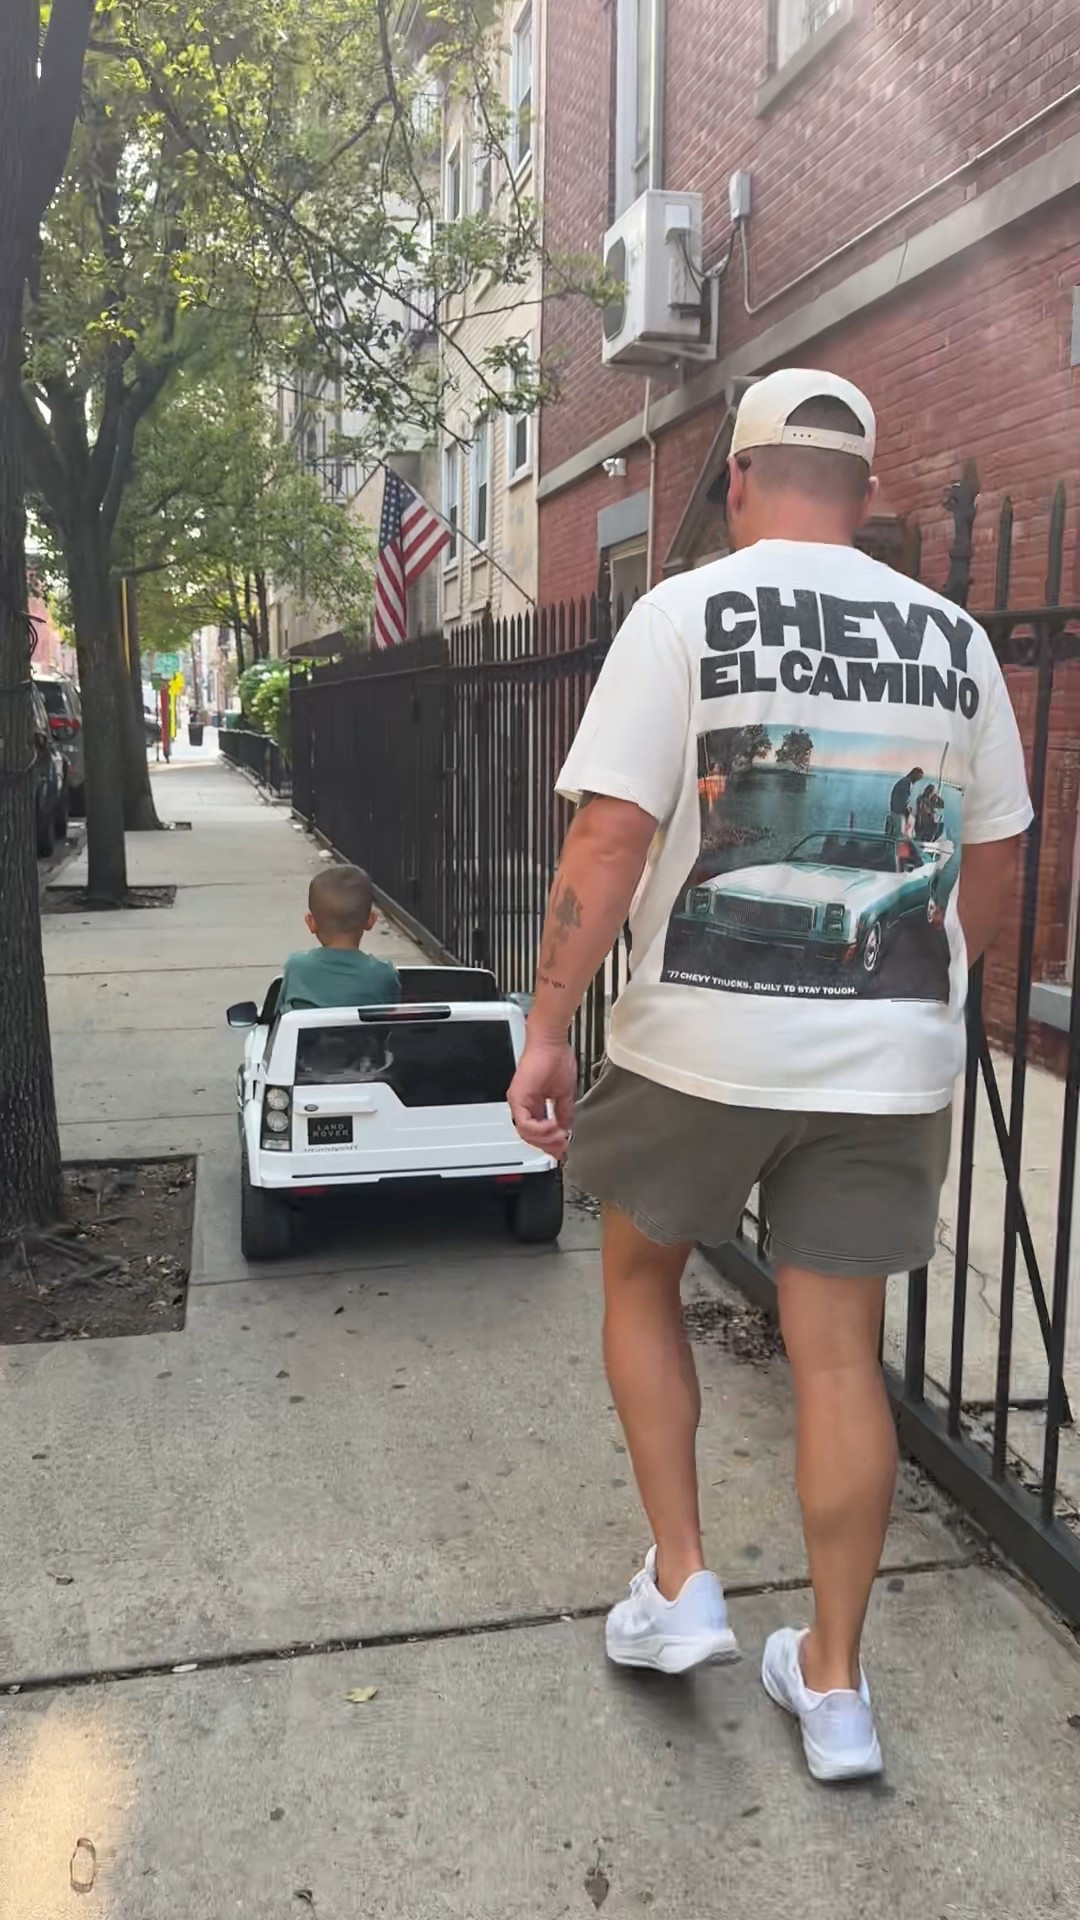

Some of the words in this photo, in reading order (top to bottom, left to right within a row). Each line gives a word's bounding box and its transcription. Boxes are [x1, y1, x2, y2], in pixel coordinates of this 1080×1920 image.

[705, 586, 974, 674] CHEVY
[700, 651, 777, 700] EL
[779, 650, 980, 720] CAMINO
[680, 972, 710, 983] CHEVY
[712, 976, 752, 989] TRUCKS.
[754, 982, 781, 991] BUILT
[783, 984, 796, 993] TO
[798, 985, 821, 994] STAY
[822, 986, 858, 995] TOUGH.
[312, 1129, 349, 1138] ROVER
[317, 1123, 345, 1131] LAND
